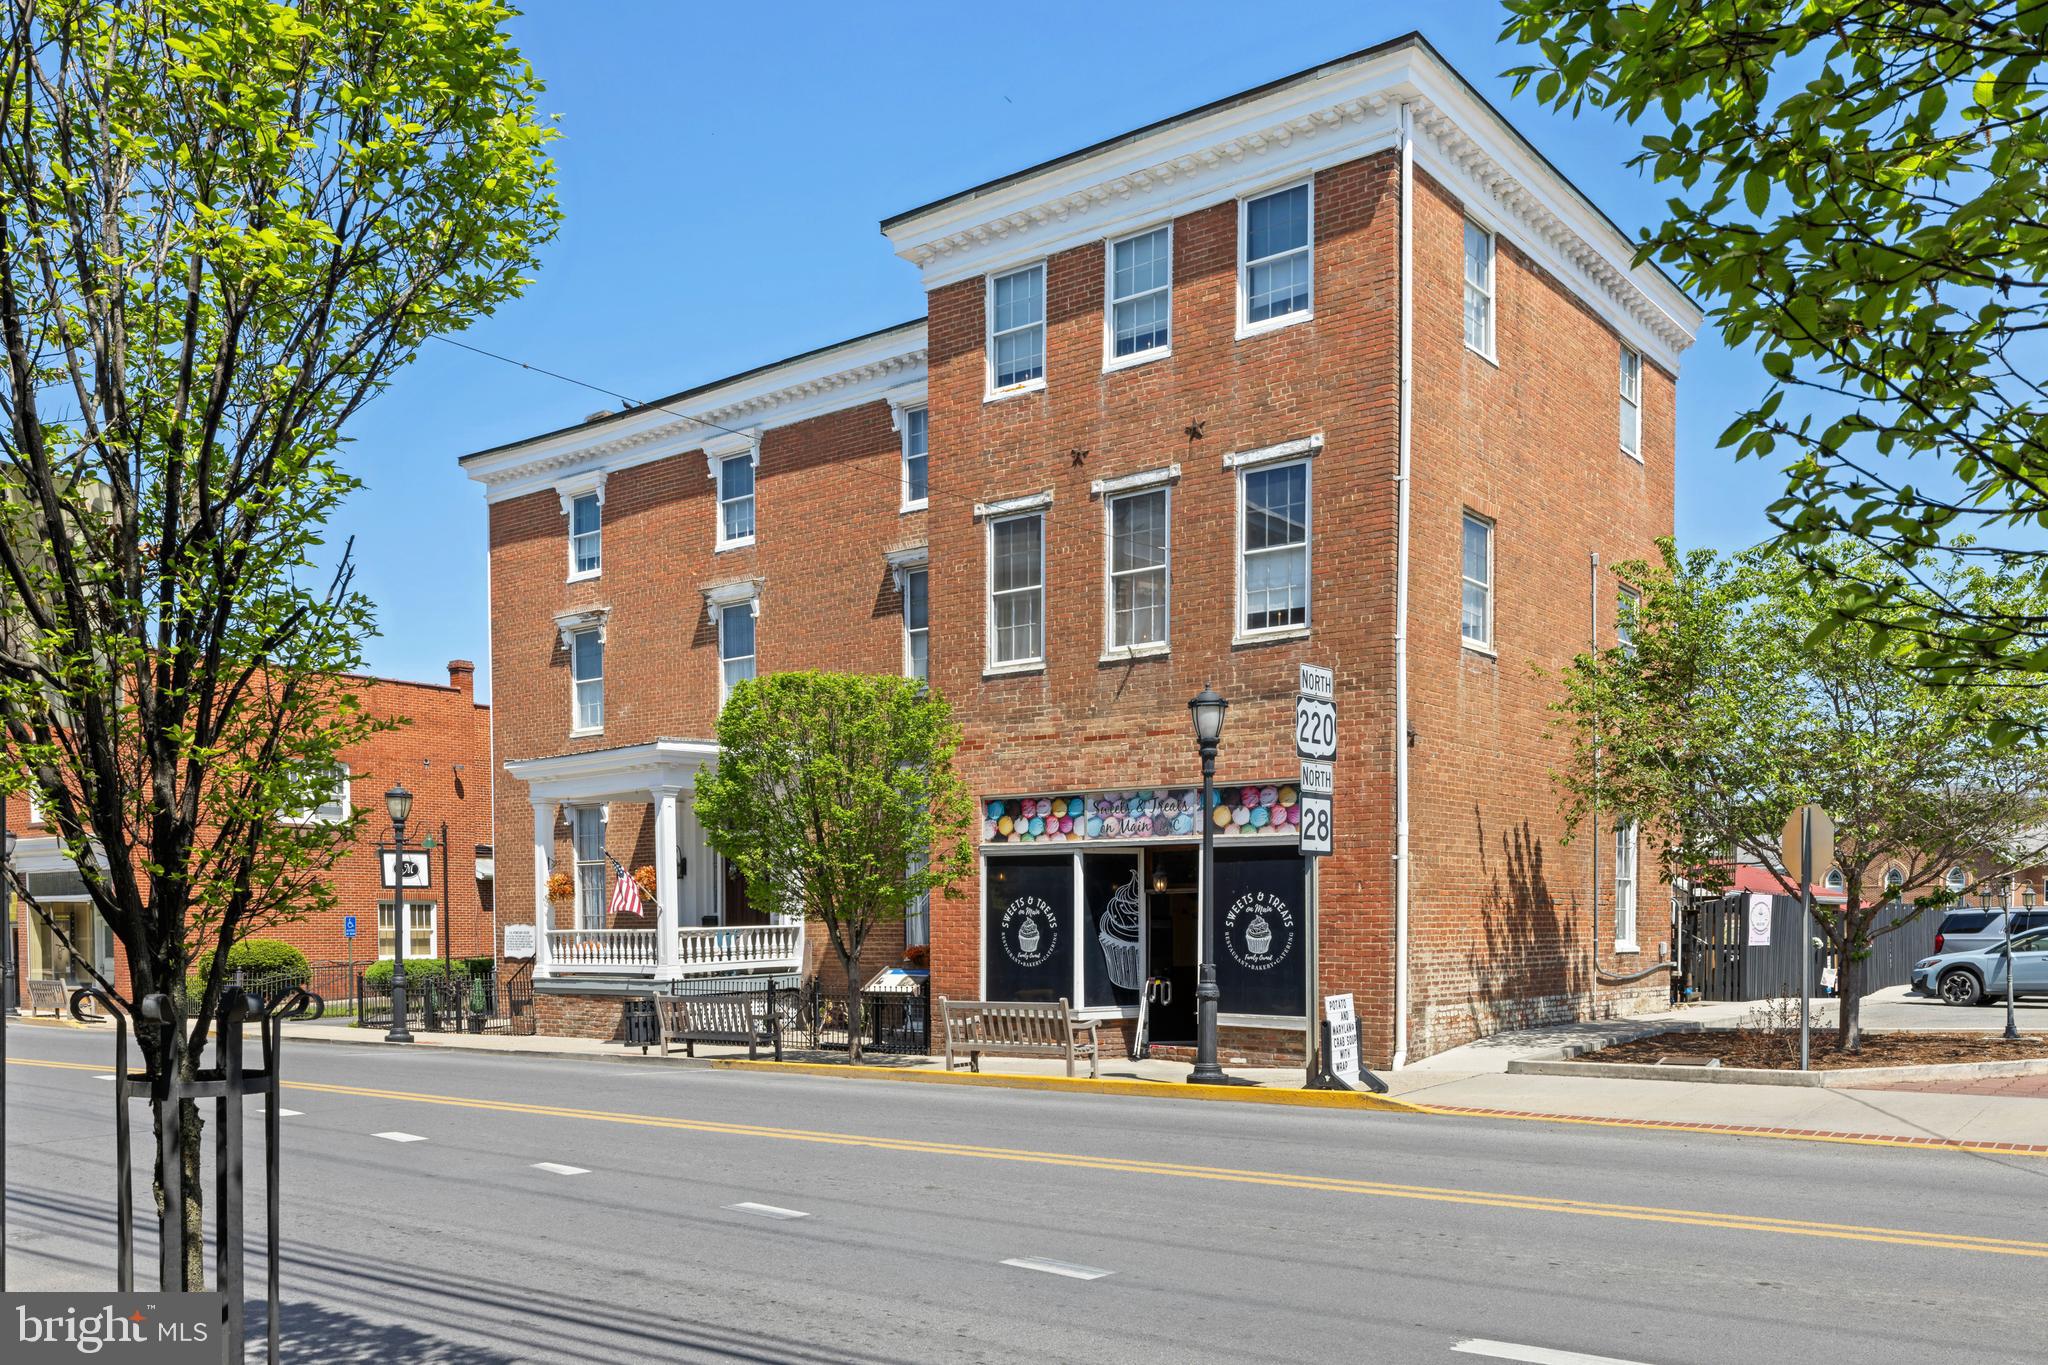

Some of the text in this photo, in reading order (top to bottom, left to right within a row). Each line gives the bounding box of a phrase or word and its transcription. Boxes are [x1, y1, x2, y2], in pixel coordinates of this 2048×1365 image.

[1302, 669, 1331, 694] NORTH
[1300, 709, 1334, 747] 220
[1302, 766, 1331, 789] NORTH
[1091, 796, 1190, 816] Sweets & Treats
[1100, 823, 1114, 833] on
[1120, 819, 1151, 834] Main
[1303, 807, 1329, 842] 28
[1002, 895, 1058, 929] SWEETS & TREATS
[1225, 891, 1294, 928] SWEETS & TREATS
[1254, 903, 1273, 915] Main
[1224, 931, 1294, 971] RESTAURANT BAKERY CATERING
[1329, 998, 1347, 1011] POTATO
[1340, 1010, 1349, 1021] AND
[1332, 1023, 1355, 1036] MARYLAND
[1333, 1034, 1357, 1048] CRAB SOUP
[1340, 1048, 1351, 1059] WITH
[1336, 1061, 1348, 1072] WRAP
